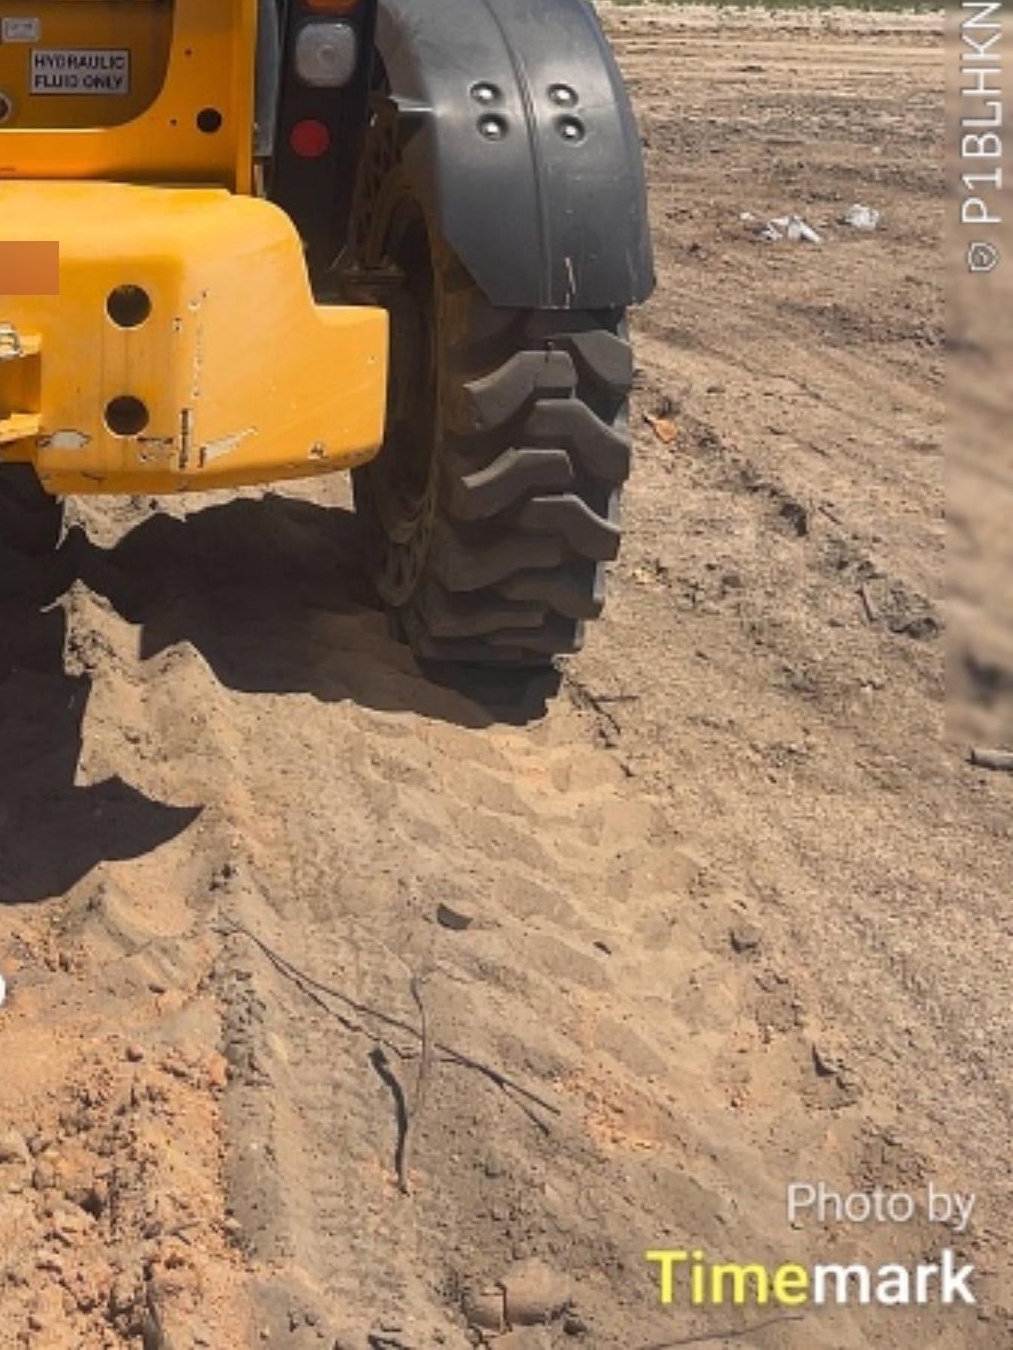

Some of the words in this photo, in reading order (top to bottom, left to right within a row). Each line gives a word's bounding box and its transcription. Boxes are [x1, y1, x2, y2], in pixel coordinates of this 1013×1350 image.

[35, 54, 125, 70] HYDRAULIC
[35, 74, 78, 88] FLUID
[82, 74, 123, 89] ONLY
